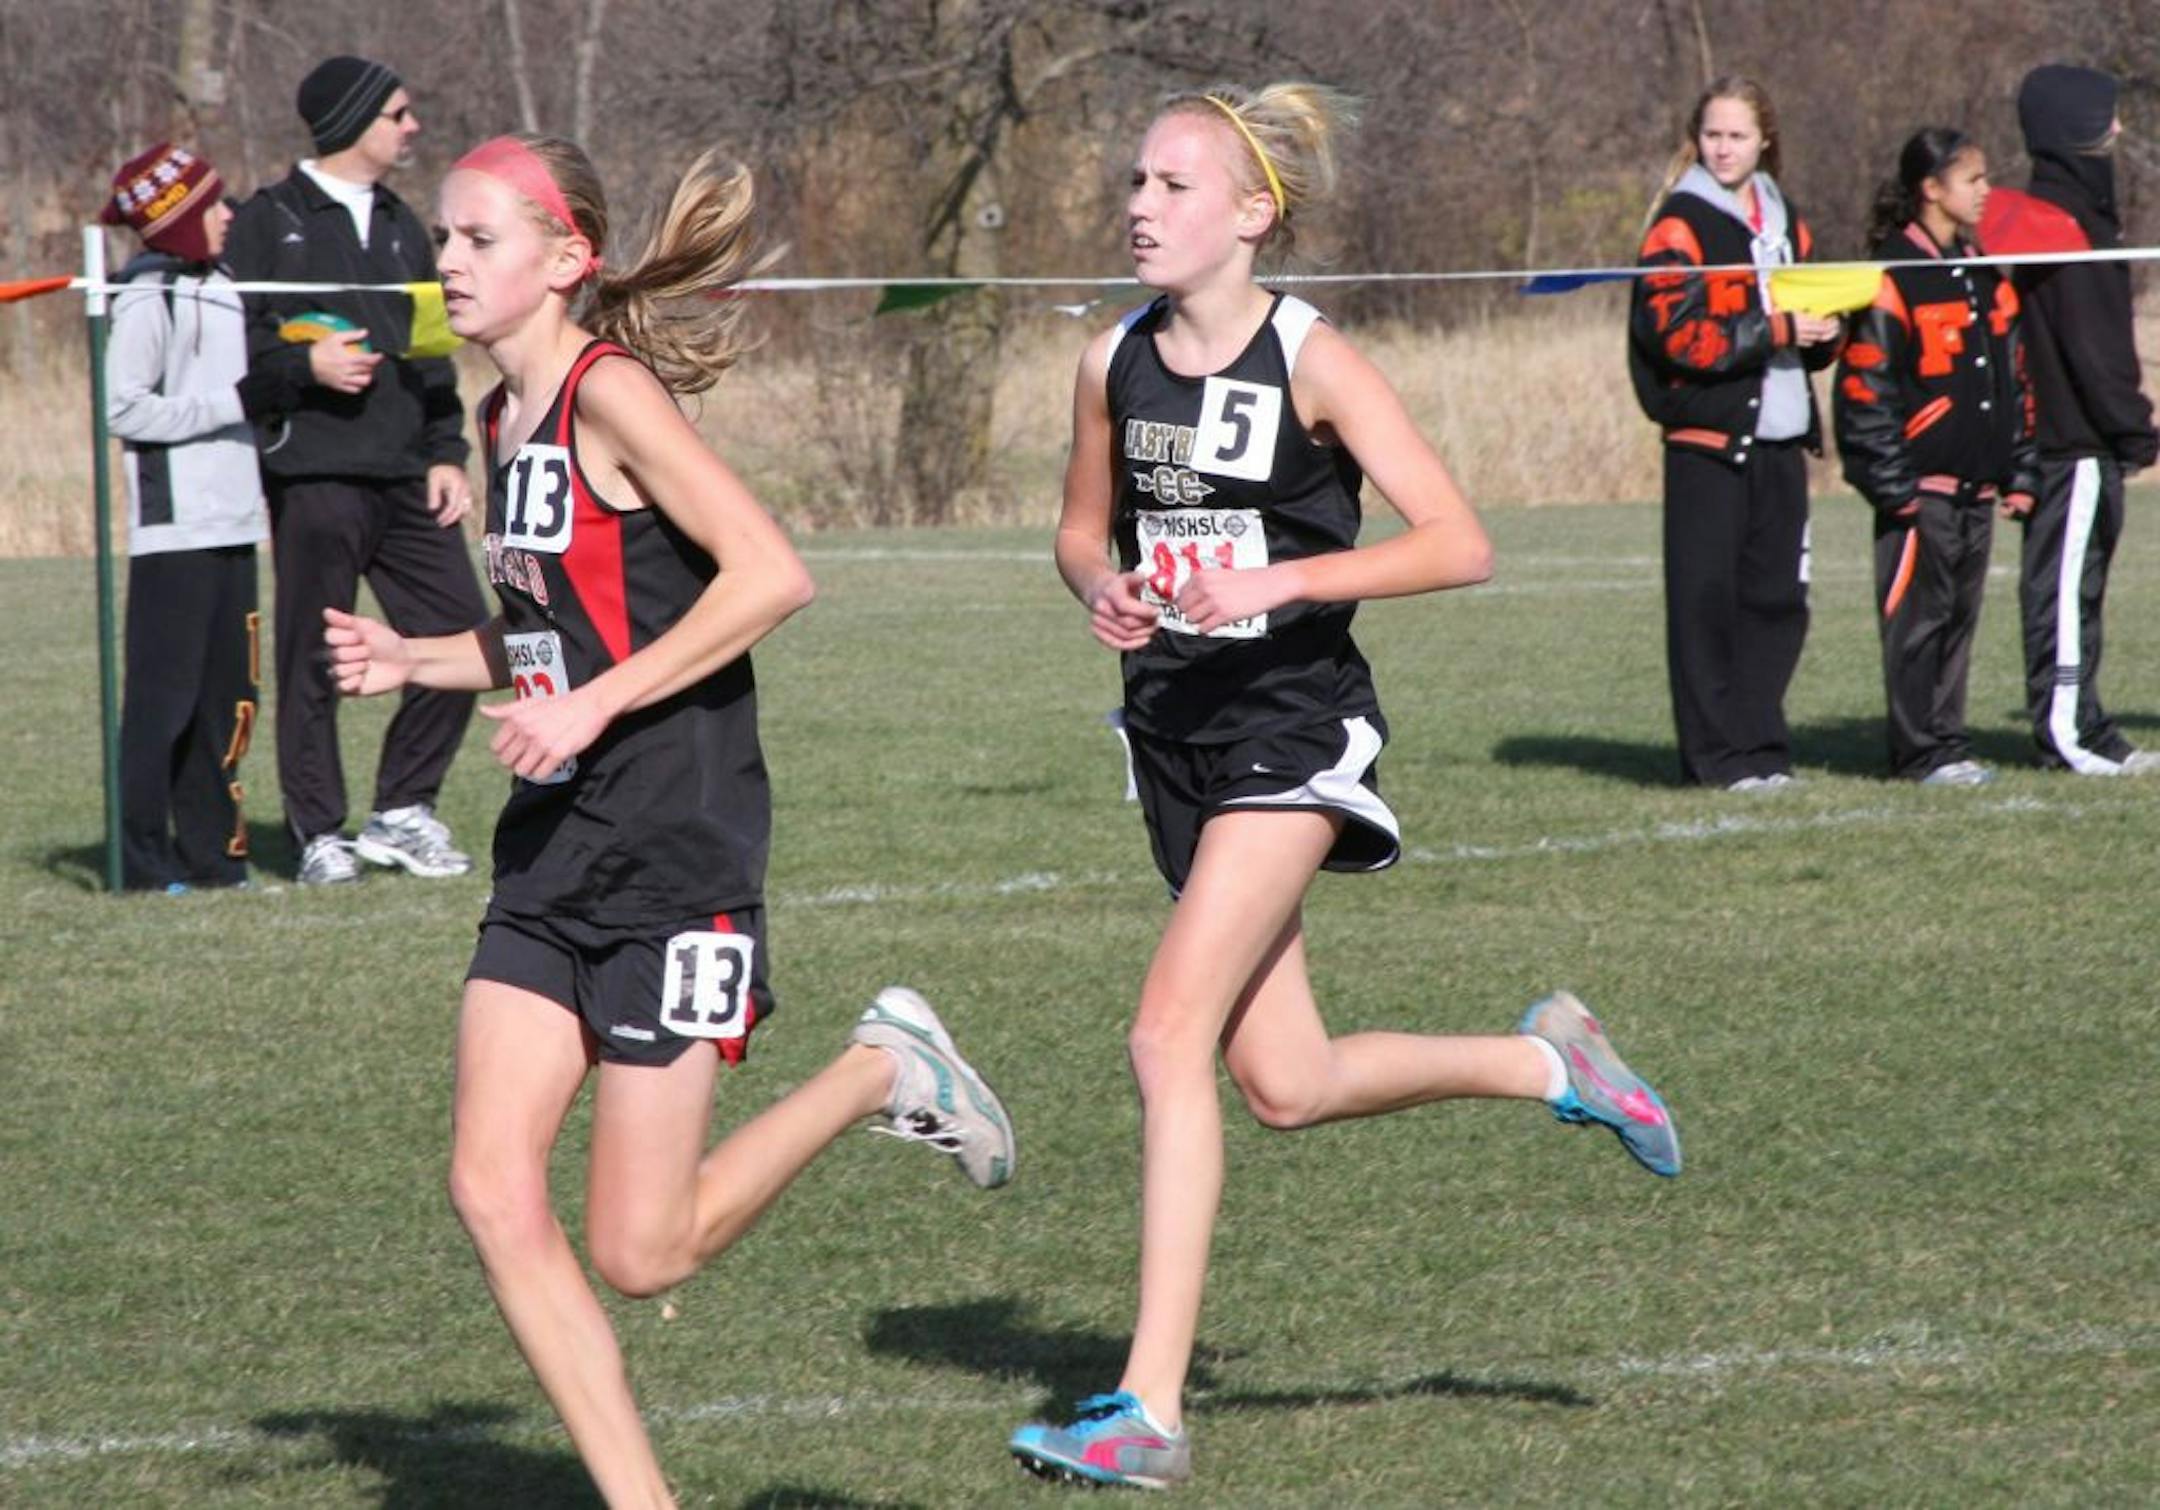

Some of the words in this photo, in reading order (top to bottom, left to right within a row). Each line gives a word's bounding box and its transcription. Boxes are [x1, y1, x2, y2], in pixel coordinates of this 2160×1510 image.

[1214, 389, 1258, 462] 5
[510, 456, 570, 538] 13
[669, 944, 745, 1025] 13
